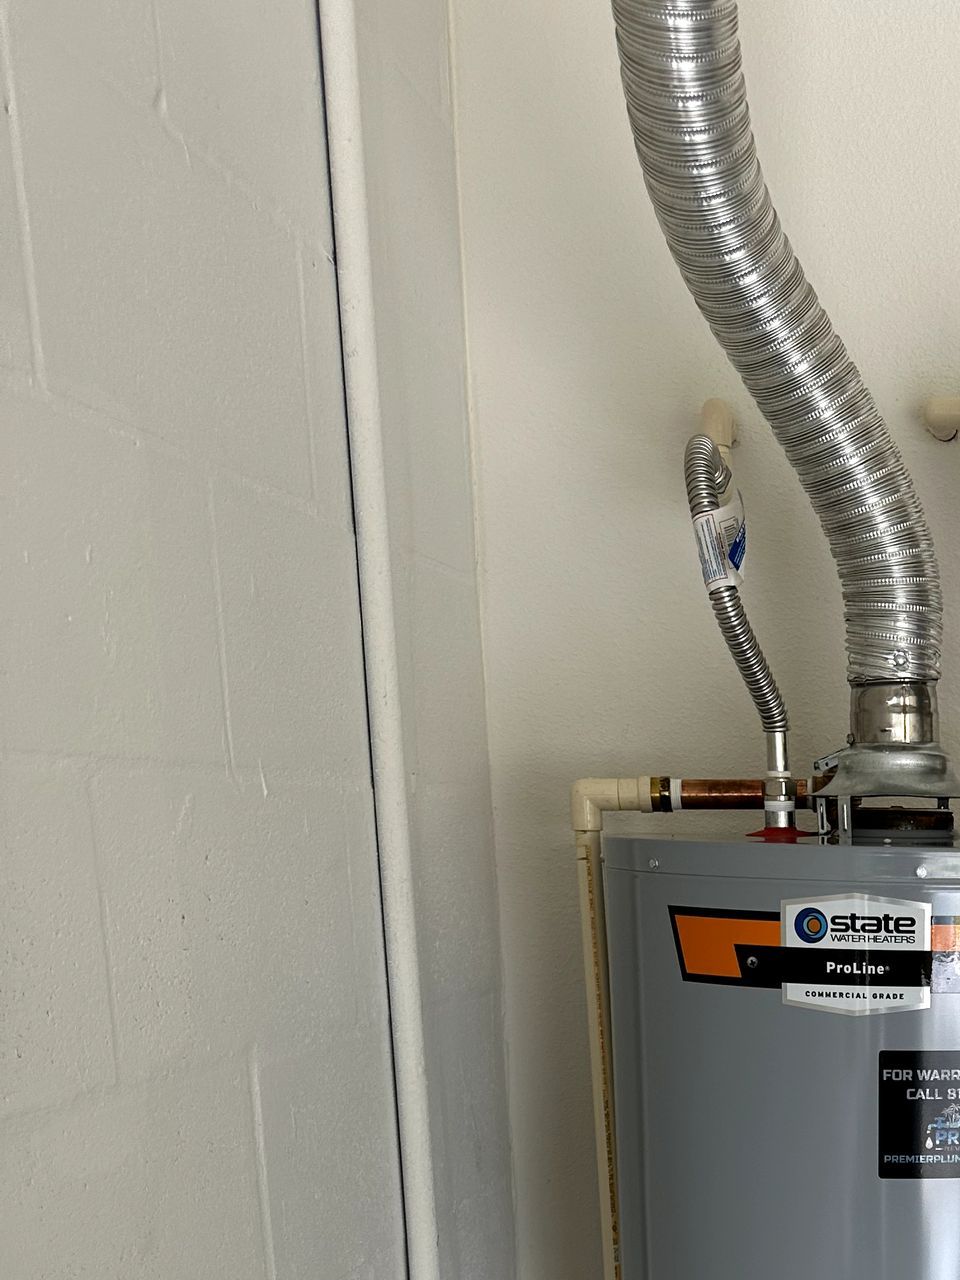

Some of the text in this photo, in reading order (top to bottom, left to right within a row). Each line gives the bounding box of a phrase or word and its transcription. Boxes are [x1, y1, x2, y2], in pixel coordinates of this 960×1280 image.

[830, 913, 916, 934] state
[831, 934, 915, 944] WATER HEATERS
[805, 991, 867, 999] COMMERCIAL
[883, 1070, 912, 1081] FOR
[906, 1089, 943, 1100] CALL
